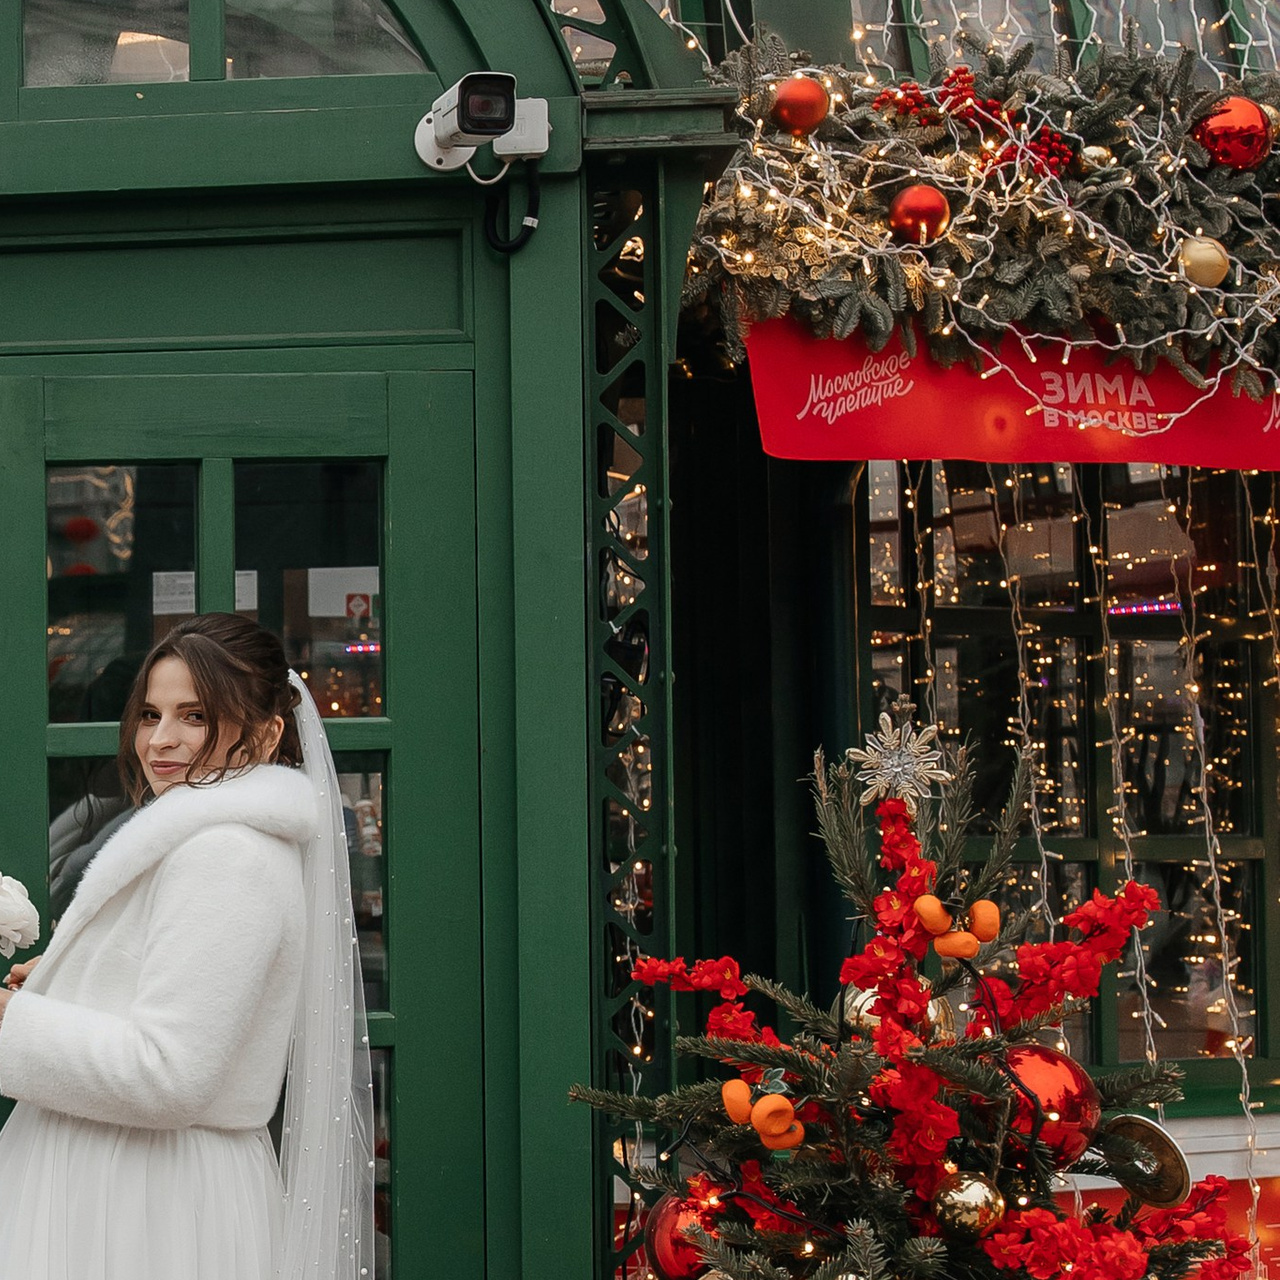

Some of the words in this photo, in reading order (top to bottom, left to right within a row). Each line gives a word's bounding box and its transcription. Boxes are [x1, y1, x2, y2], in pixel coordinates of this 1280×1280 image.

[796, 350, 911, 420] Московское
[812, 373, 914, 425] чаепитие
[1040, 371, 1156, 407] ЗИМА
[1042, 407, 1060, 428] В
[1067, 409, 1159, 431] МОСКВЕ
